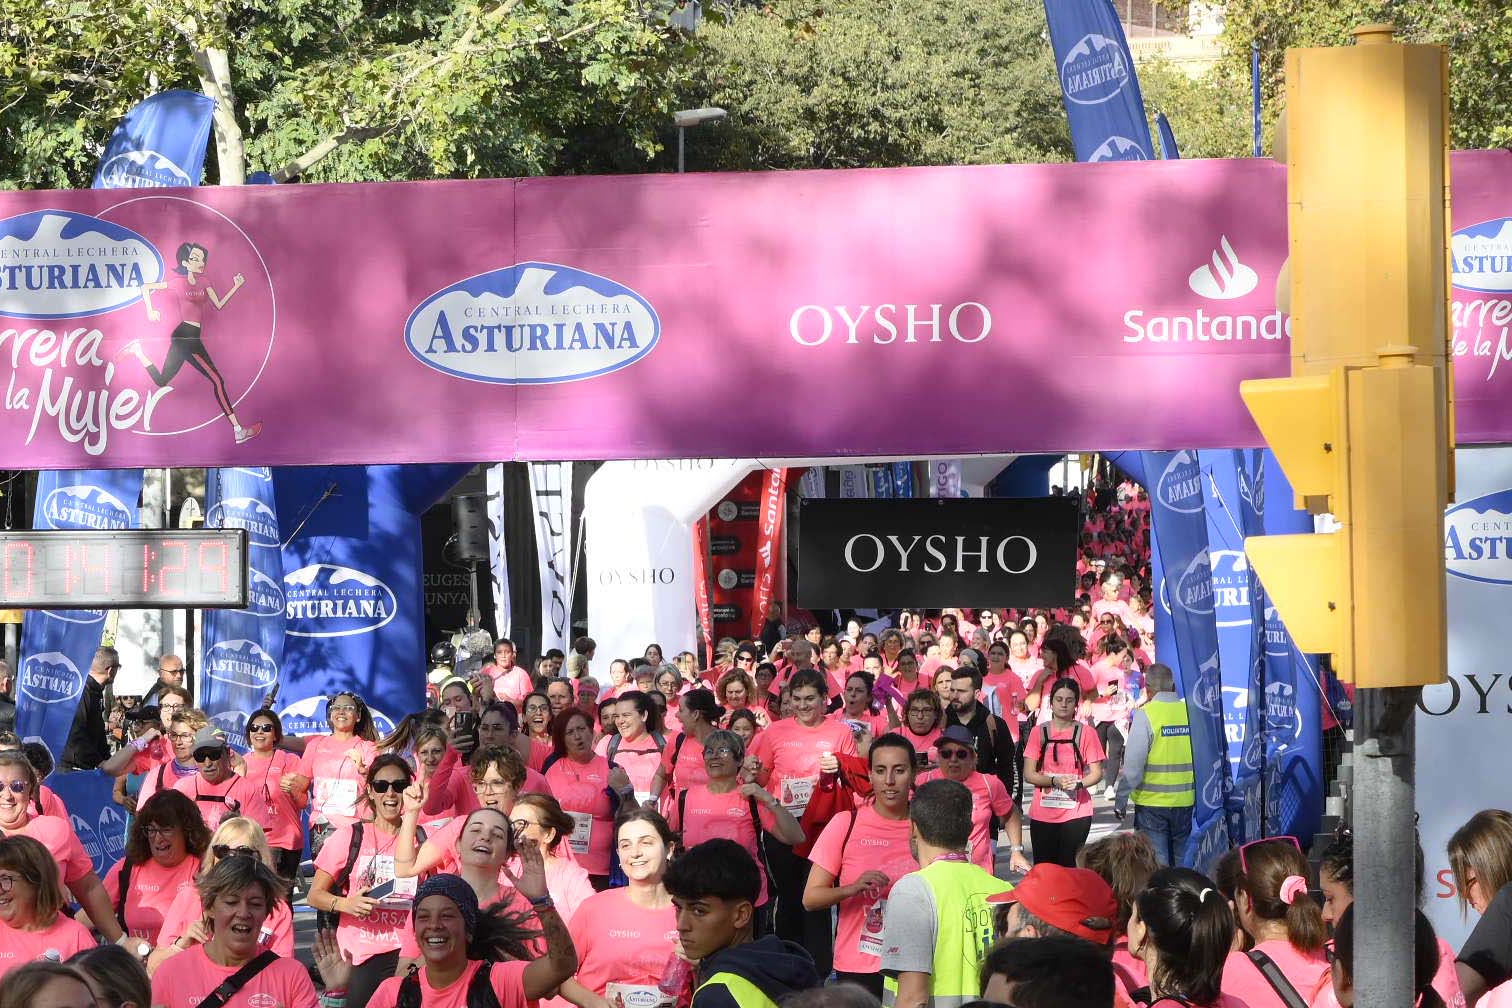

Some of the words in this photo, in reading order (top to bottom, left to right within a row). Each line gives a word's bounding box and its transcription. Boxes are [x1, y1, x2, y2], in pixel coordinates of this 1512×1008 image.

[67, 247, 141, 257] LECHERA
[1452, 250, 1512, 274] STU
[464, 305, 542, 318] CENTRAL
[550, 303, 632, 316] LECHERA
[789, 302, 992, 345] OYSHO
[424, 309, 640, 355] ASTURIANA
[5, 369, 30, 411] la
[25, 366, 175, 456] Mujer
[844, 534, 1038, 574] OYSHO
[287, 589, 328, 598] CENTRAL
[335, 588, 383, 597] LECHERA
